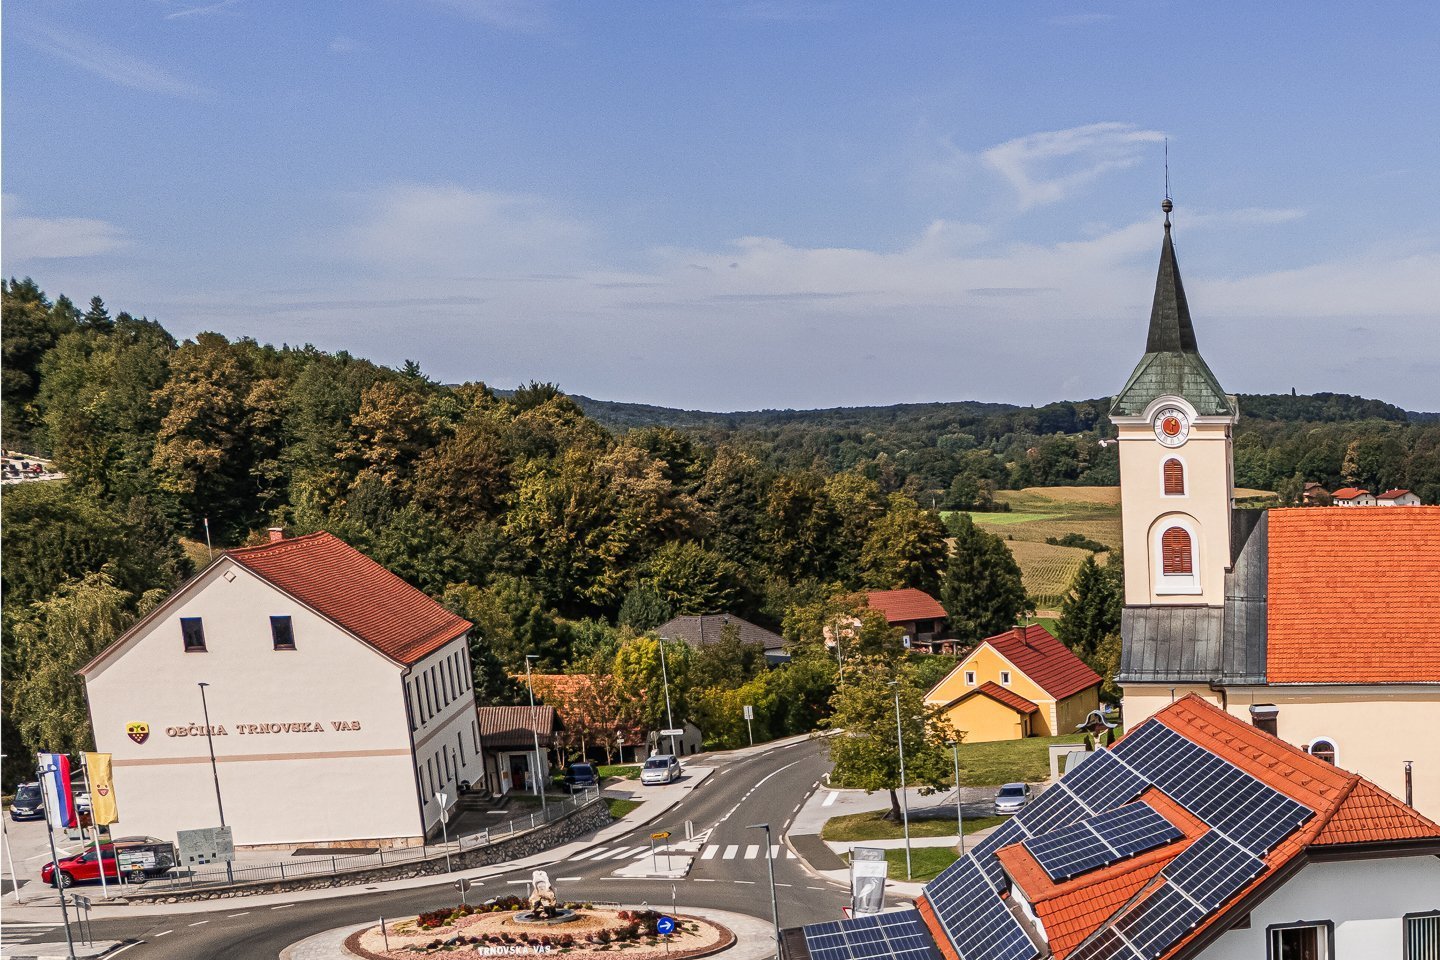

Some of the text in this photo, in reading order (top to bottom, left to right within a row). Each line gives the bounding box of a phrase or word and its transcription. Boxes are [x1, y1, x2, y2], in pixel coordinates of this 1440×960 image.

[165, 720, 362, 738] OBČINA TRNOVSKA VAS
[478, 945, 551, 956] TRNOVSKA VAS
